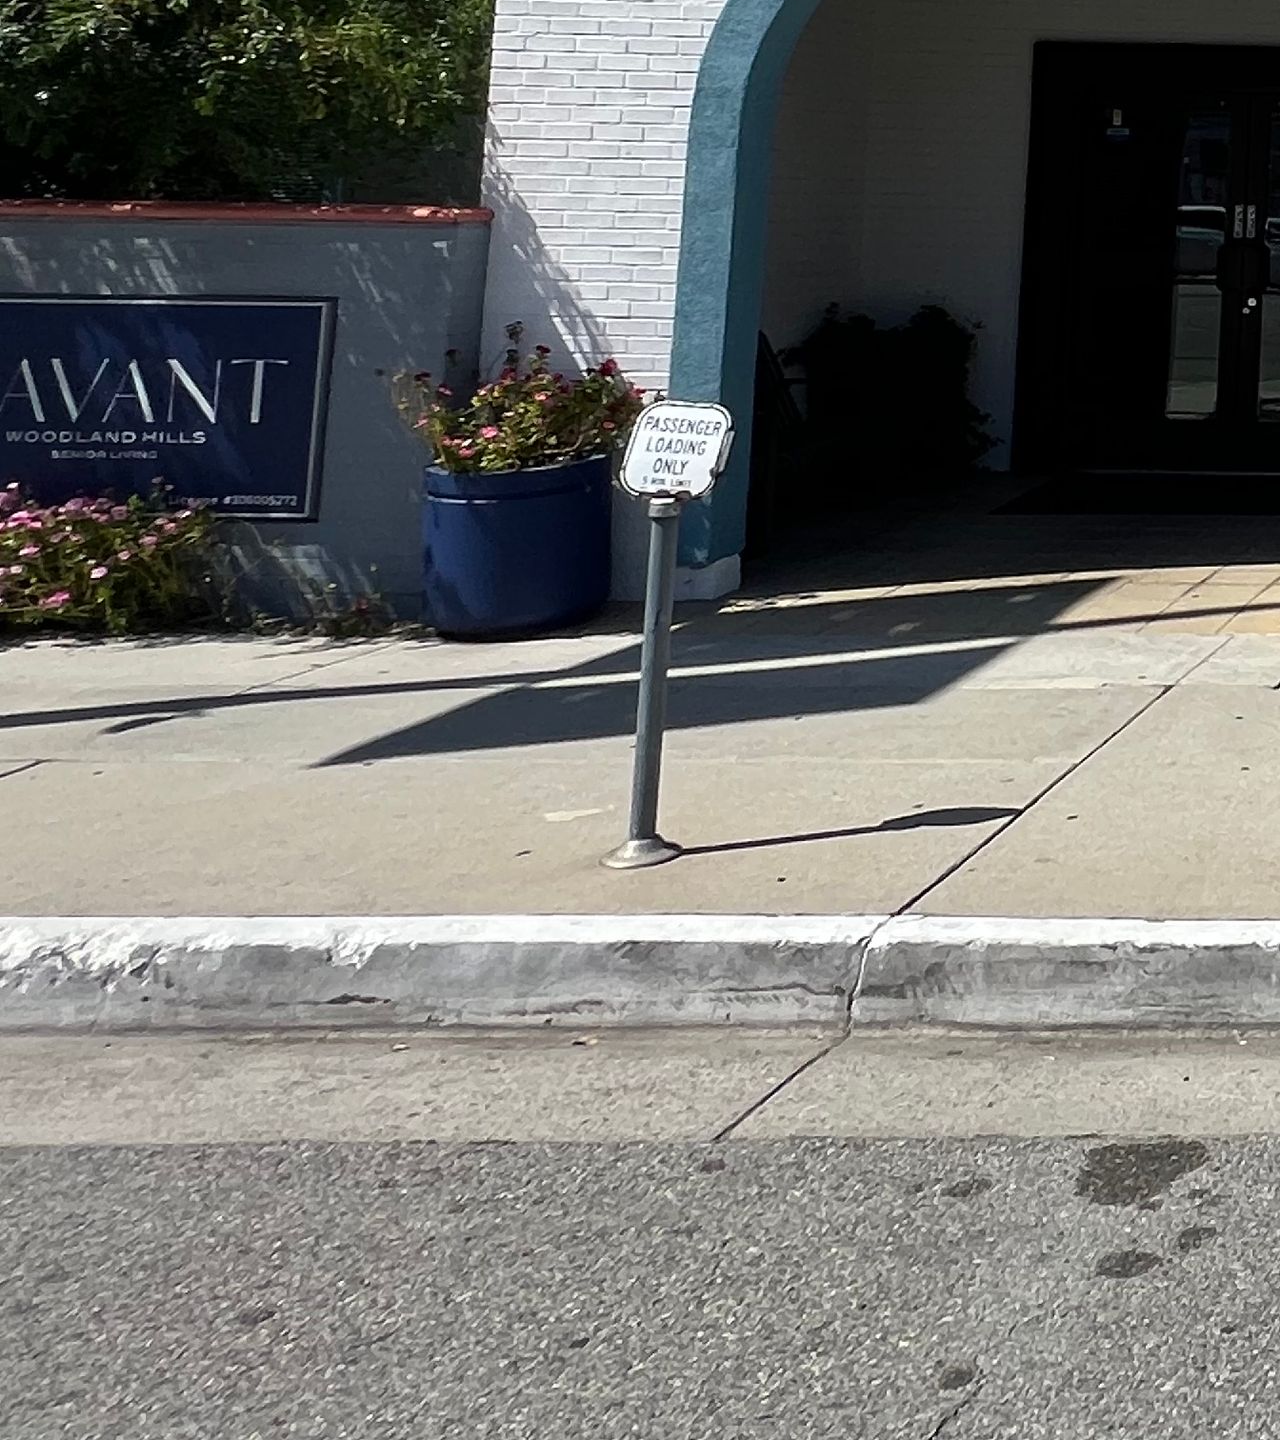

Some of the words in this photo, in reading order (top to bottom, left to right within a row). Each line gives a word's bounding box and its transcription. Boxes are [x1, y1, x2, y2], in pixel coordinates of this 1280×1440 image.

[643, 416, 722, 436] PASSENGER
[6, 431, 137, 444] WOODLAND
[142, 431, 206, 444] HILLS
[645, 436, 708, 456] LOADING
[652, 457, 689, 475] ONLY
